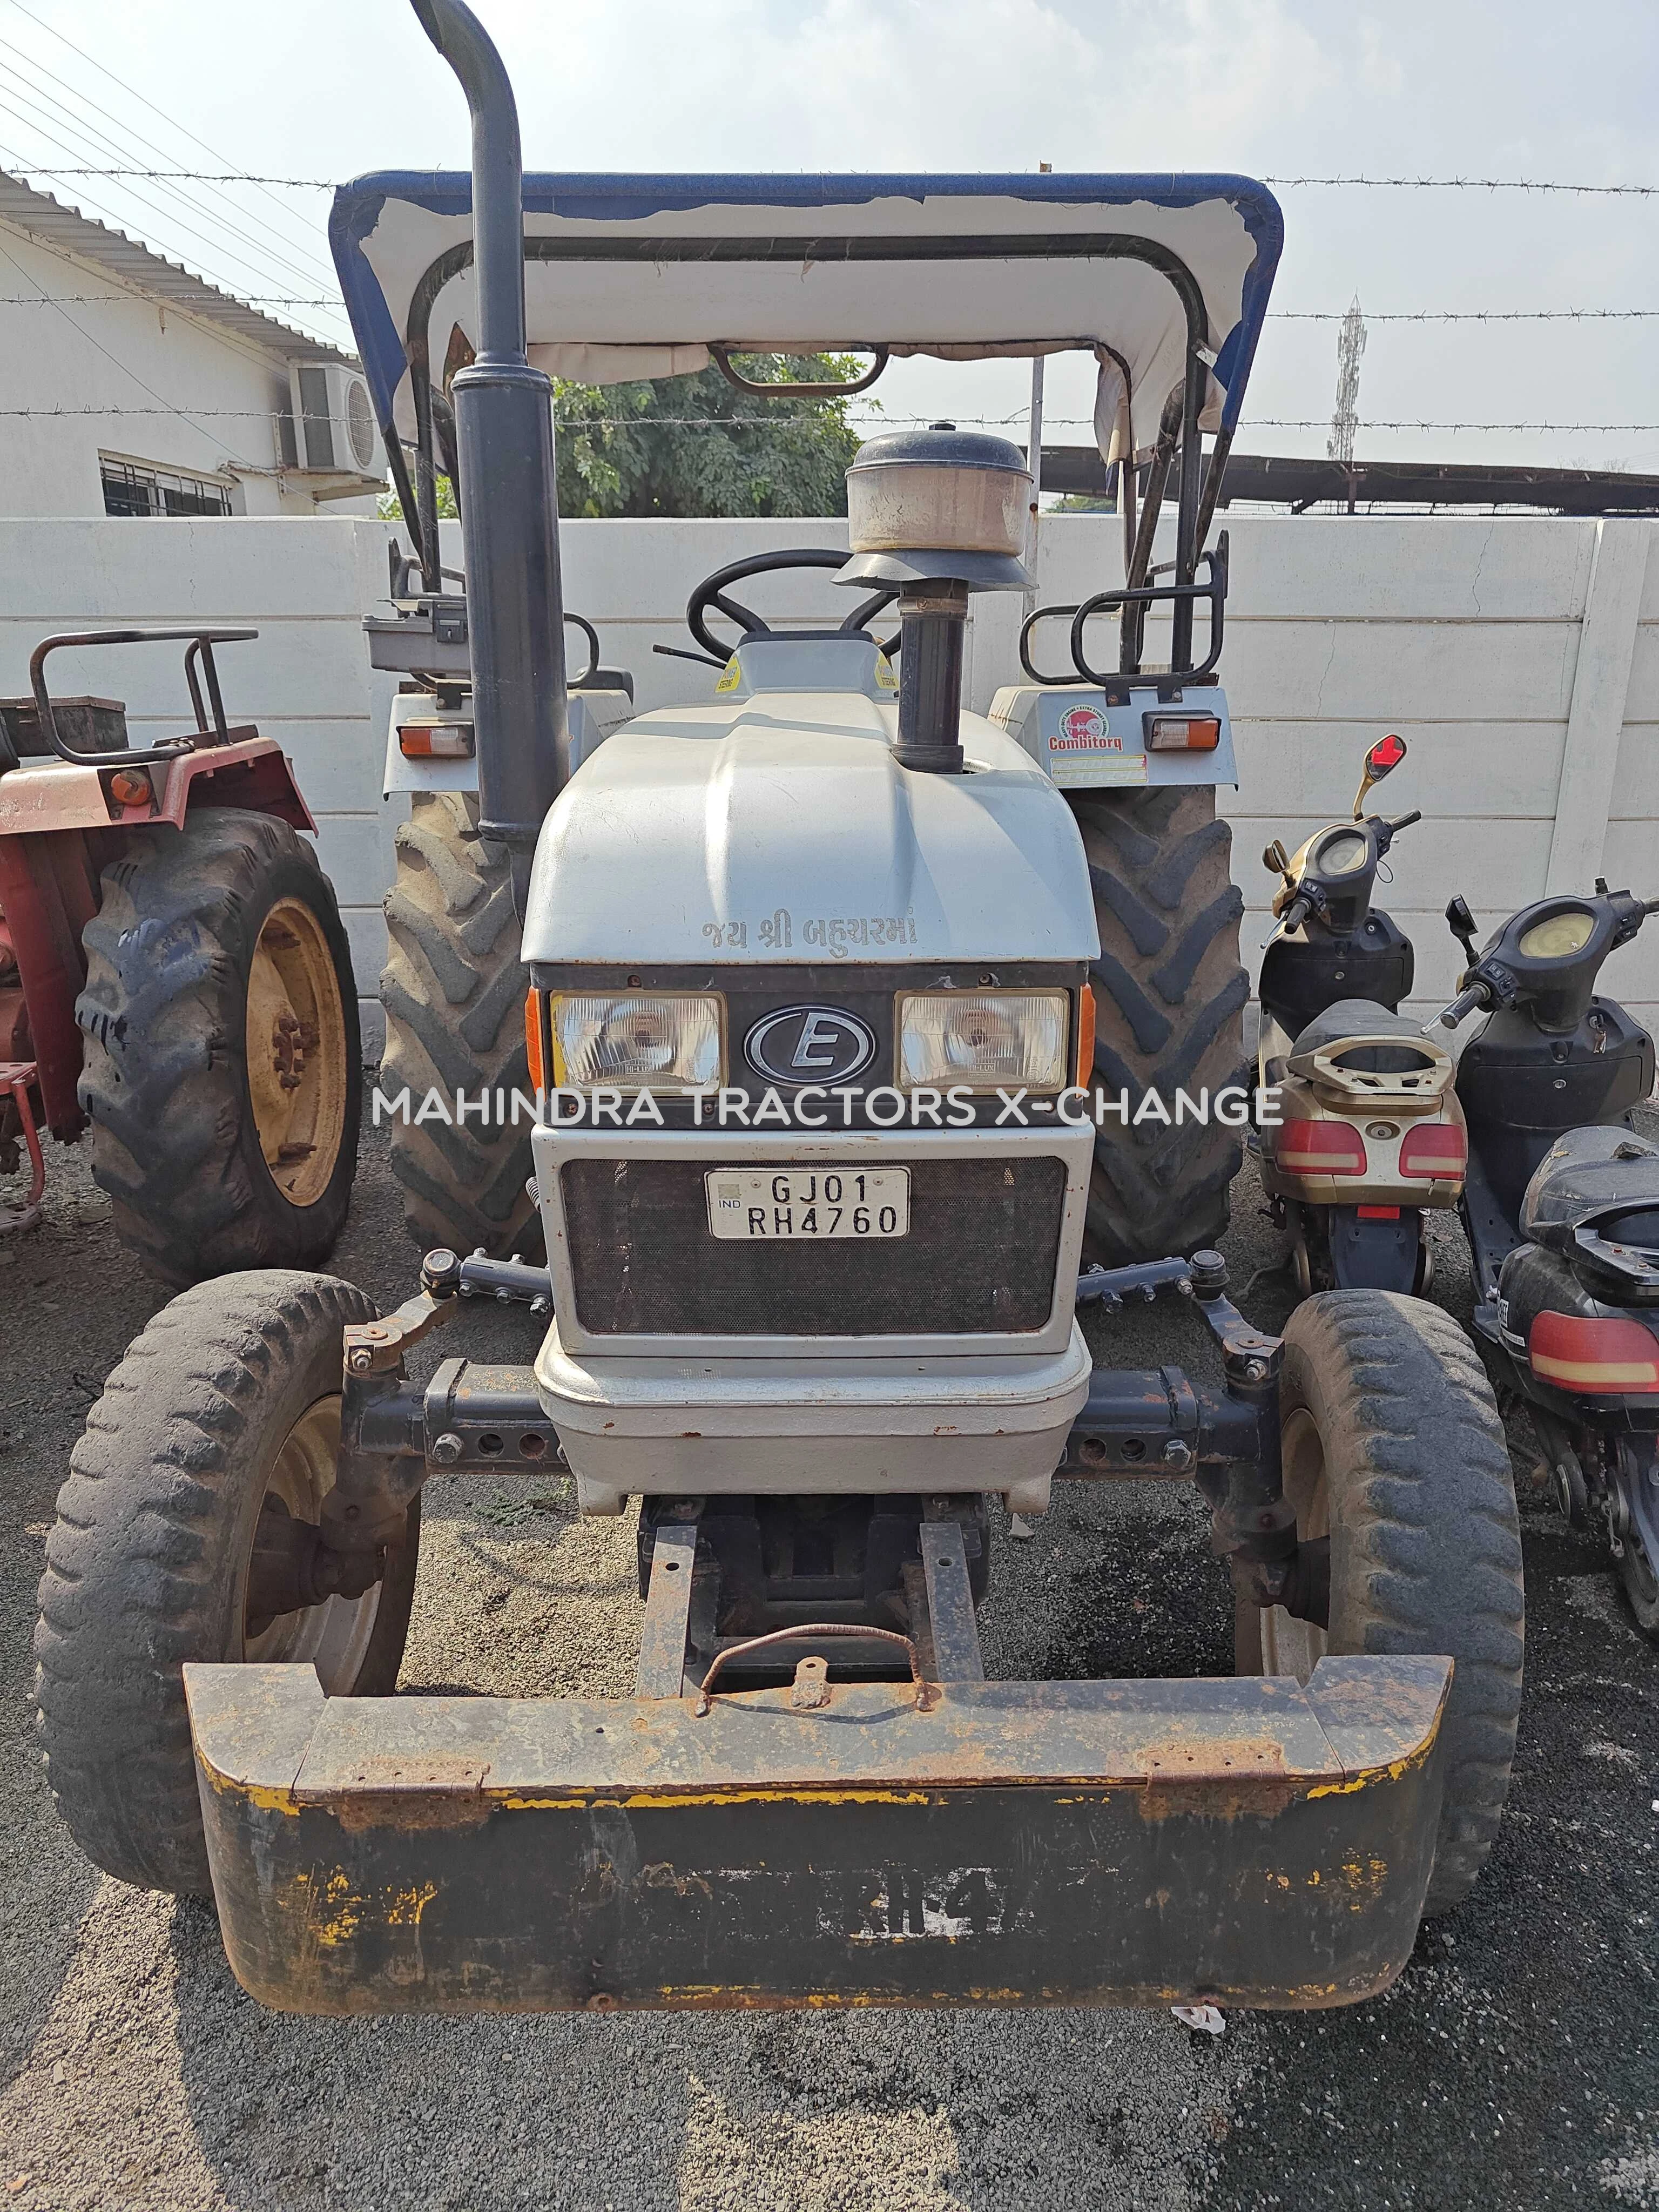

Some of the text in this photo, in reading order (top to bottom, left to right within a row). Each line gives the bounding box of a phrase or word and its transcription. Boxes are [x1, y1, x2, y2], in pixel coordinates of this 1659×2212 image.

[1049, 734, 1122, 751] Combitorq
[702, 922, 748, 949] જય
[758, 908, 793, 948] શ્રી
[772, 1175, 865, 1203] GJ01
[719, 1200, 740, 1209] IND
[748, 1206, 896, 1235] RH4760
